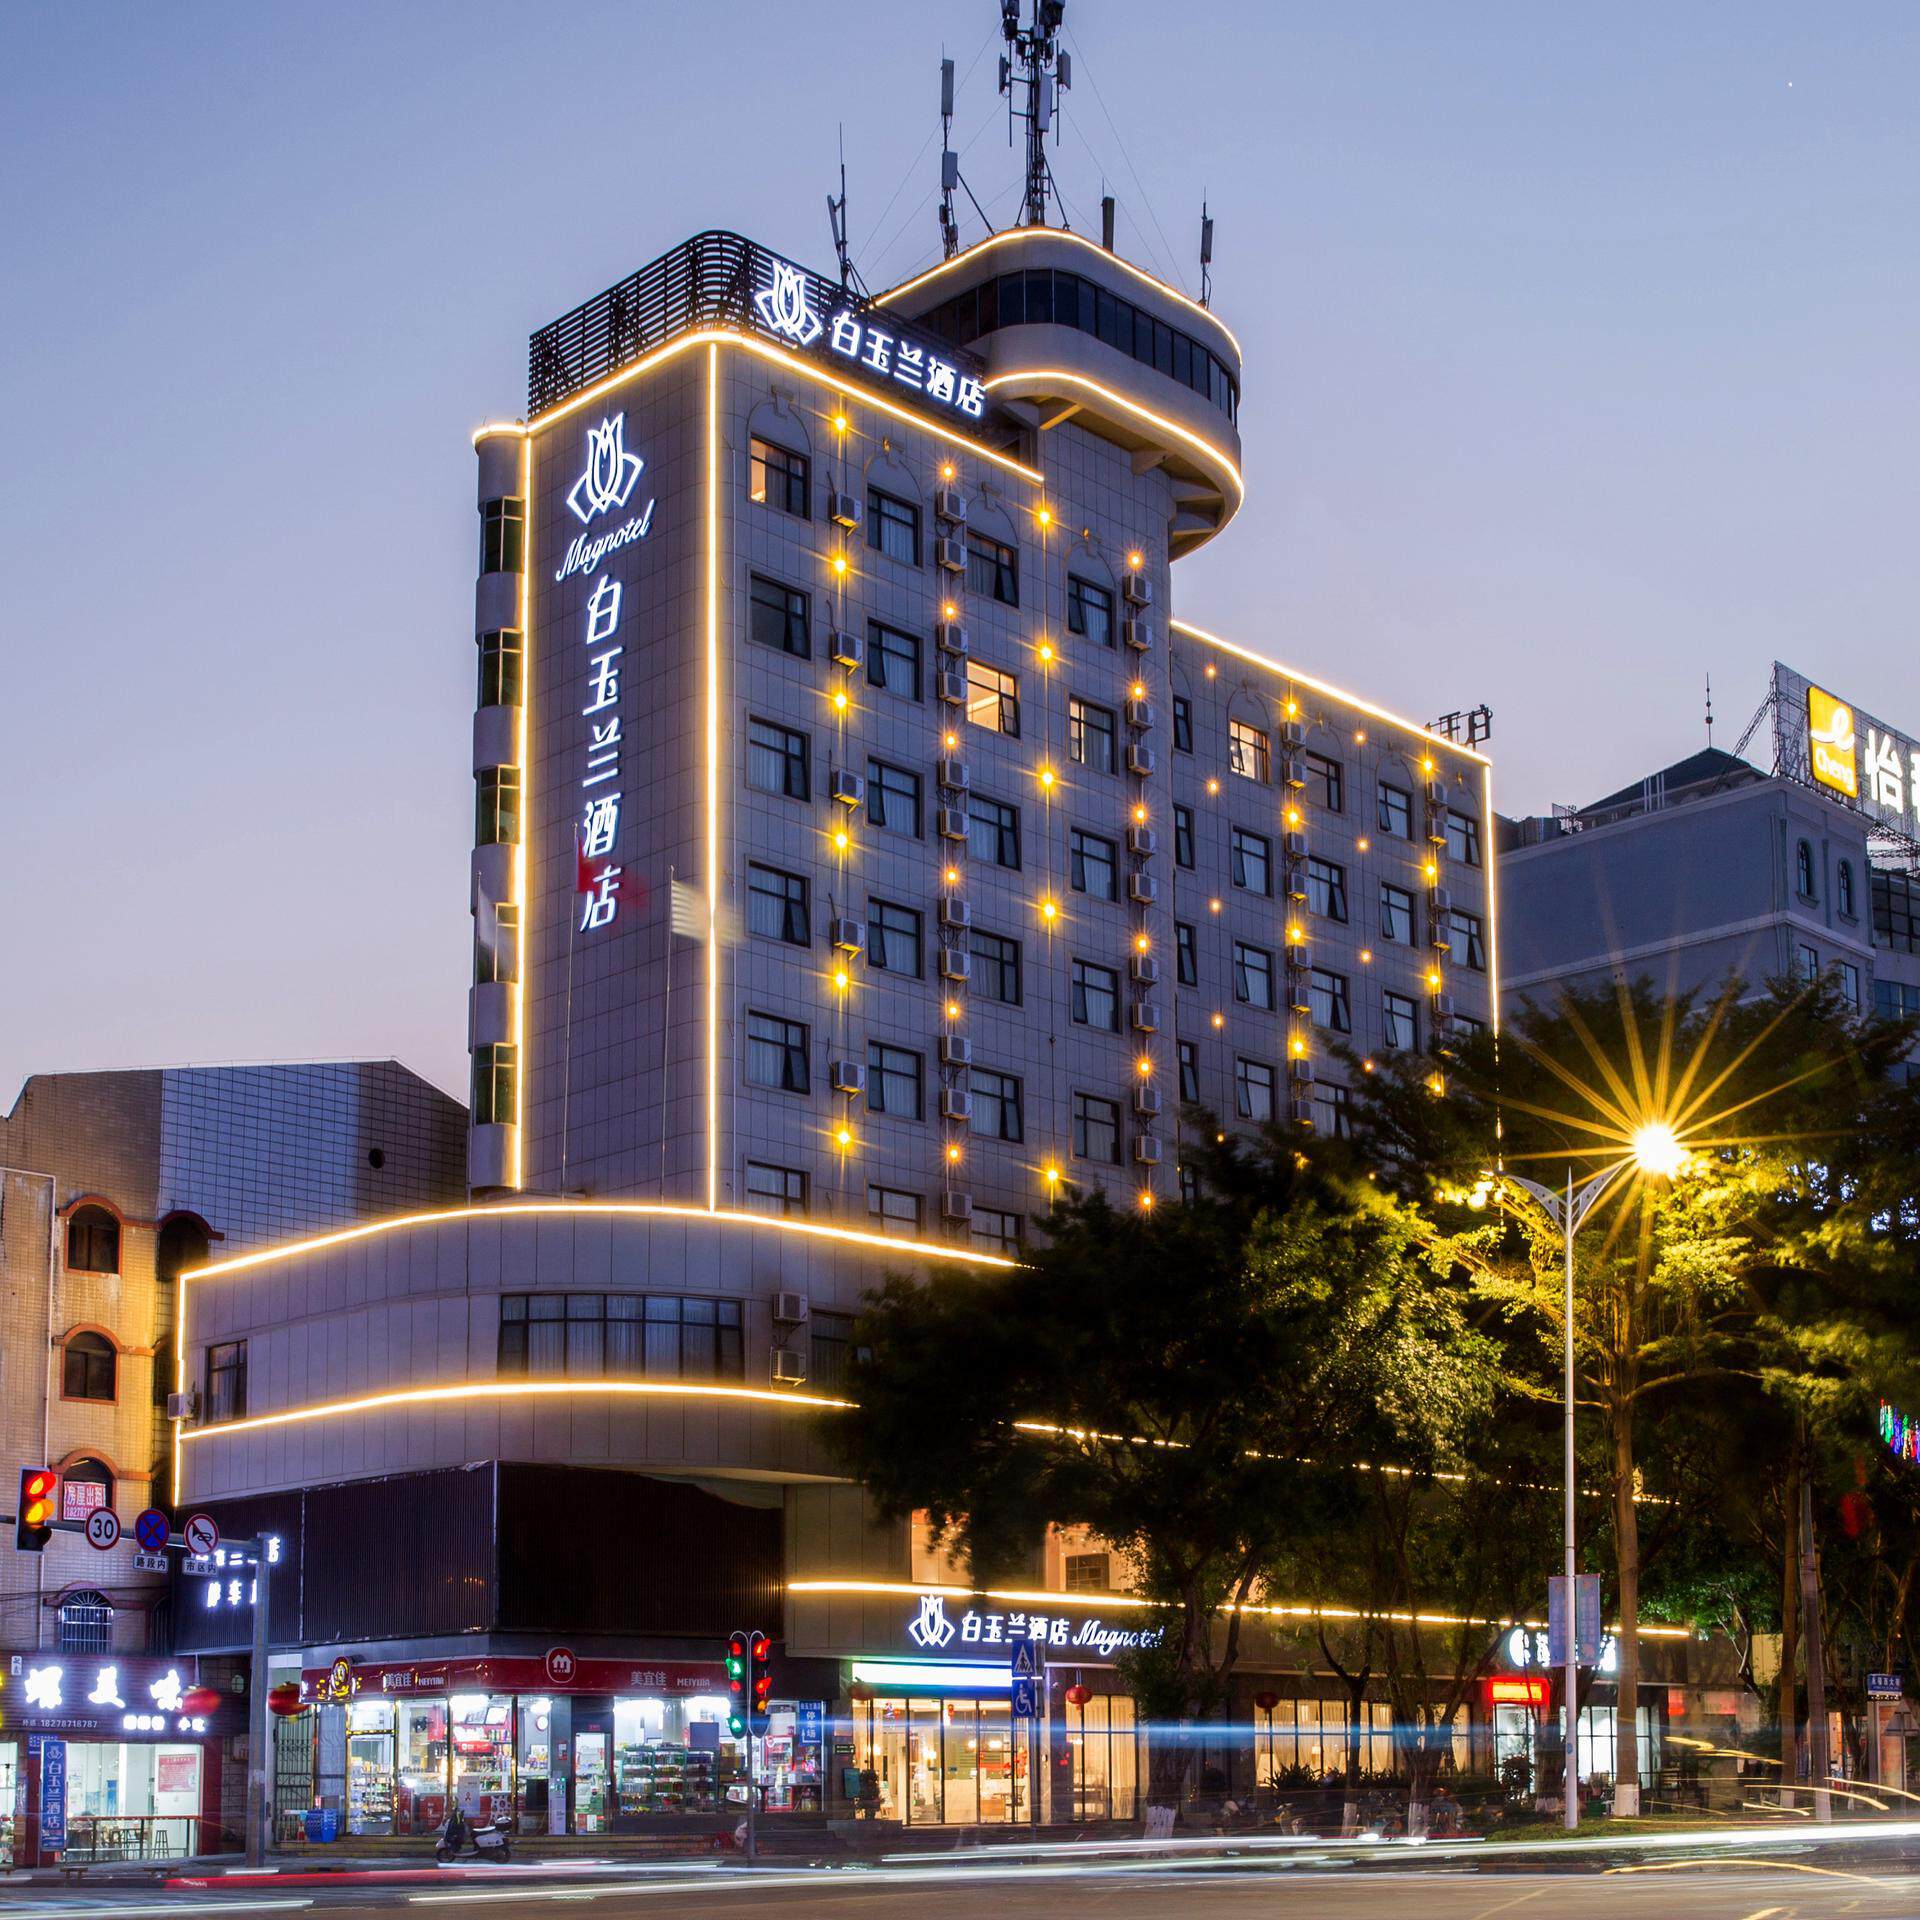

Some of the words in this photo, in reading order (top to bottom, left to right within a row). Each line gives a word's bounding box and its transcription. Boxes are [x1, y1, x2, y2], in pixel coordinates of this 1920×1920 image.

[831, 311, 987, 417] 白玉兰酒店
[556, 499, 655, 582] Magnotel
[580, 575, 624, 933] 白玉兰酒店
[1864, 729, 1920, 823] 怡
[67, 1484, 103, 1507] 房屋出租
[93, 1518, 114, 1539] 30
[136, 1556, 166, 1570] 路段内
[186, 1561, 216, 1574] 市区内
[961, 1611, 1070, 1646] 白玉兰酒店
[384, 1672, 412, 1687] 美宜佳
[631, 1671, 667, 1686] 美宜佳
[47, 1761, 62, 1829] 白玉兰酒店
